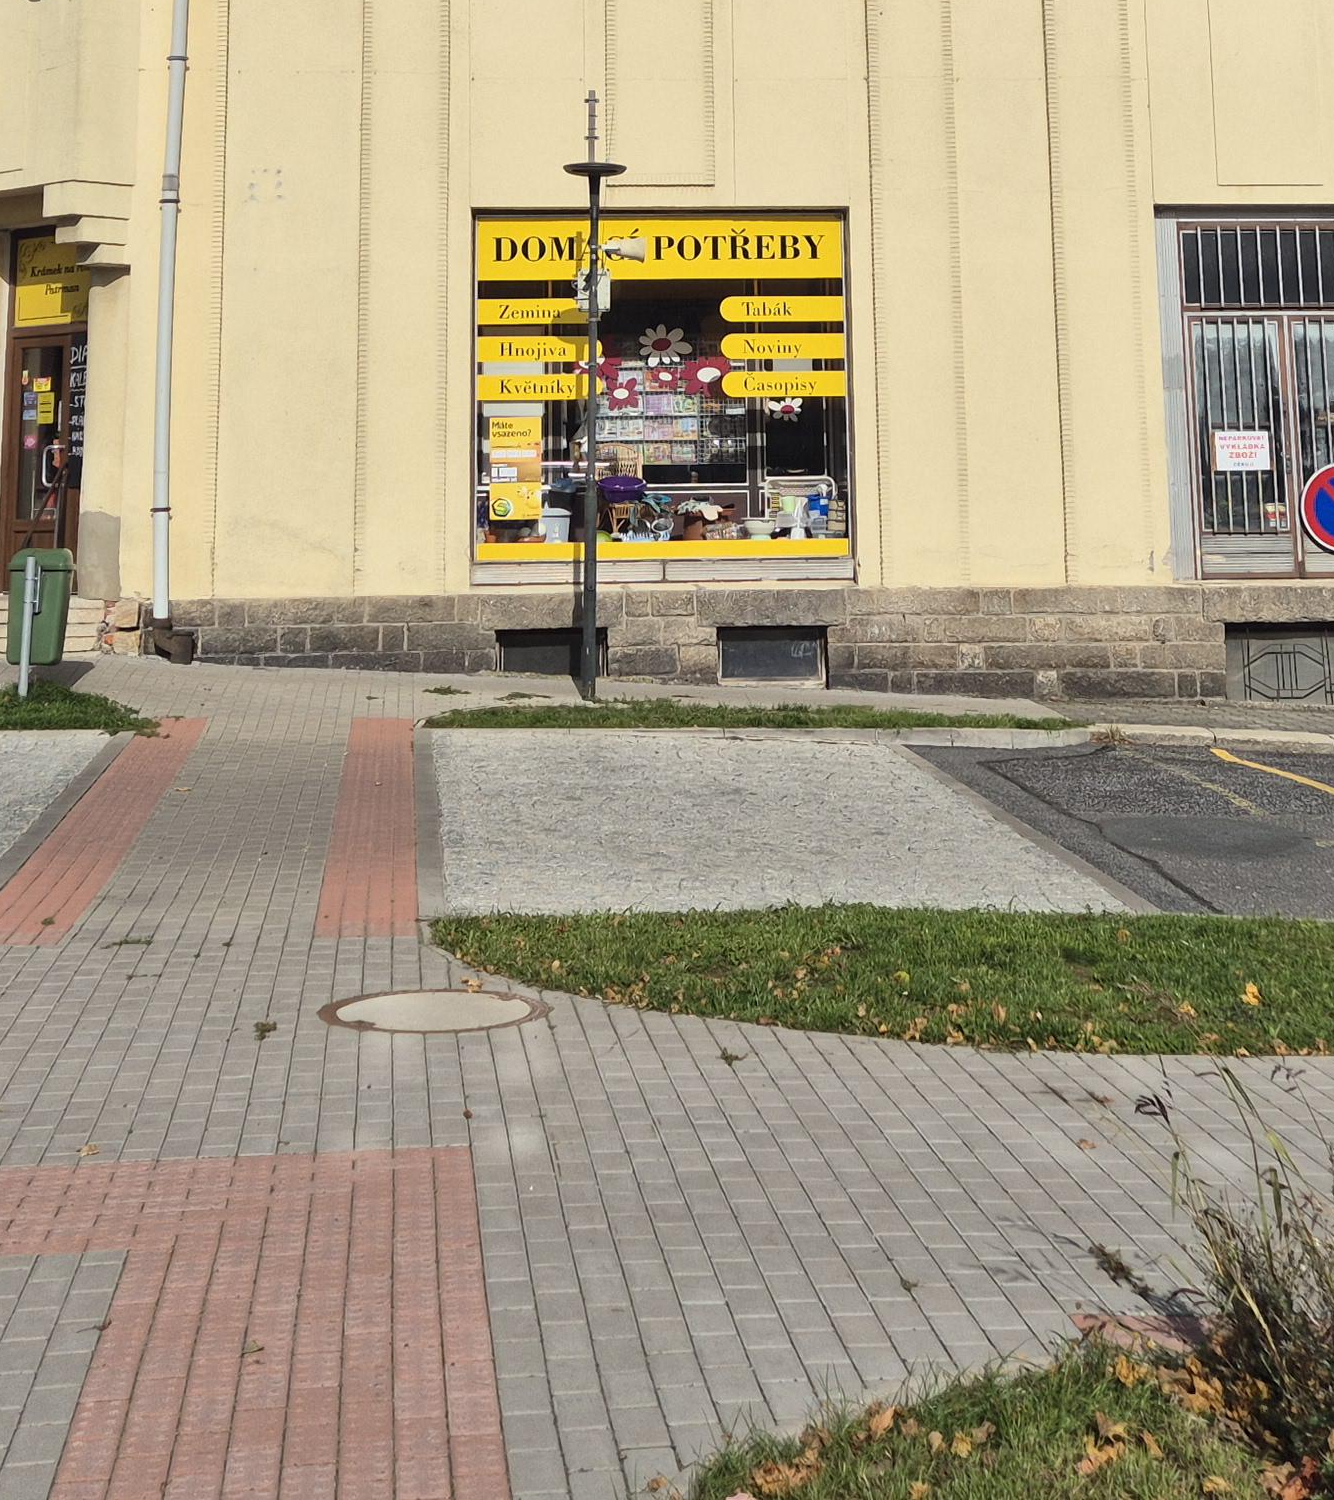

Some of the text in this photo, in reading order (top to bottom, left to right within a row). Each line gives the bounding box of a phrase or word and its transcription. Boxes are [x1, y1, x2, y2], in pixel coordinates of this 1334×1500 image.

[492, 228, 826, 263] DOMC POTŘEBY
[499, 304, 561, 320] Zemina
[741, 301, 793, 317] Tabák
[499, 341, 567, 361] Hnojiva
[742, 338, 803, 359] Noviny
[499, 379, 576, 398] Květníky
[743, 373, 818, 395] Časopisy
[492, 421, 514, 430] Máte
[492, 429, 532, 438] vsazeno?
